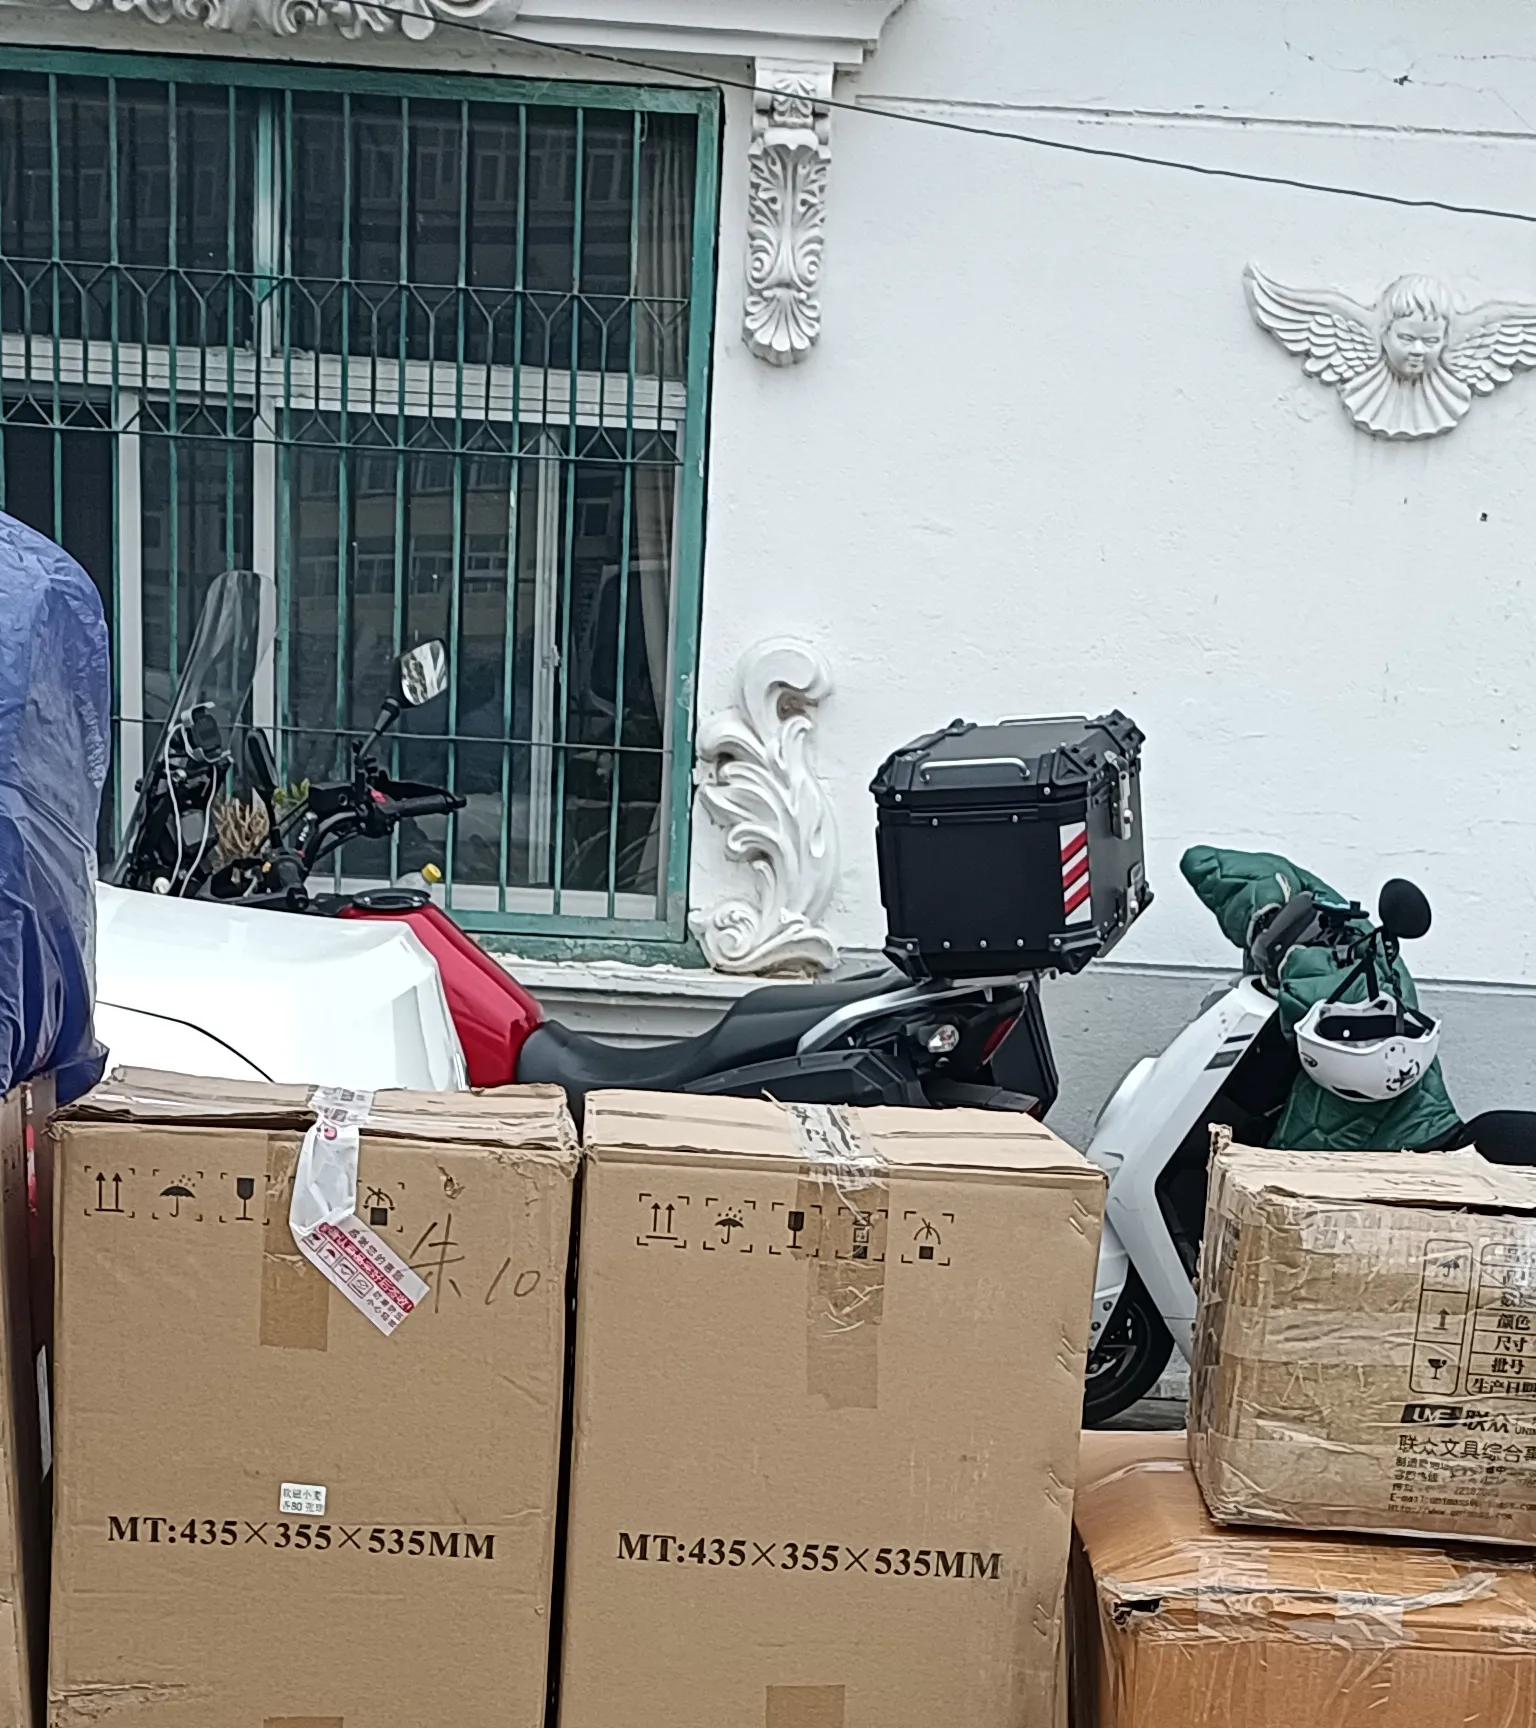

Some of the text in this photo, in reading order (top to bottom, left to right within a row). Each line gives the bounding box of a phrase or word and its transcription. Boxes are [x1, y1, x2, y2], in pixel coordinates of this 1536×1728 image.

[484, 1256, 542, 1306] 10
[1496, 1313, 1531, 1330] 颜色
[1494, 1336, 1529, 1352] 尺寸
[1491, 1357, 1526, 1375] 批号
